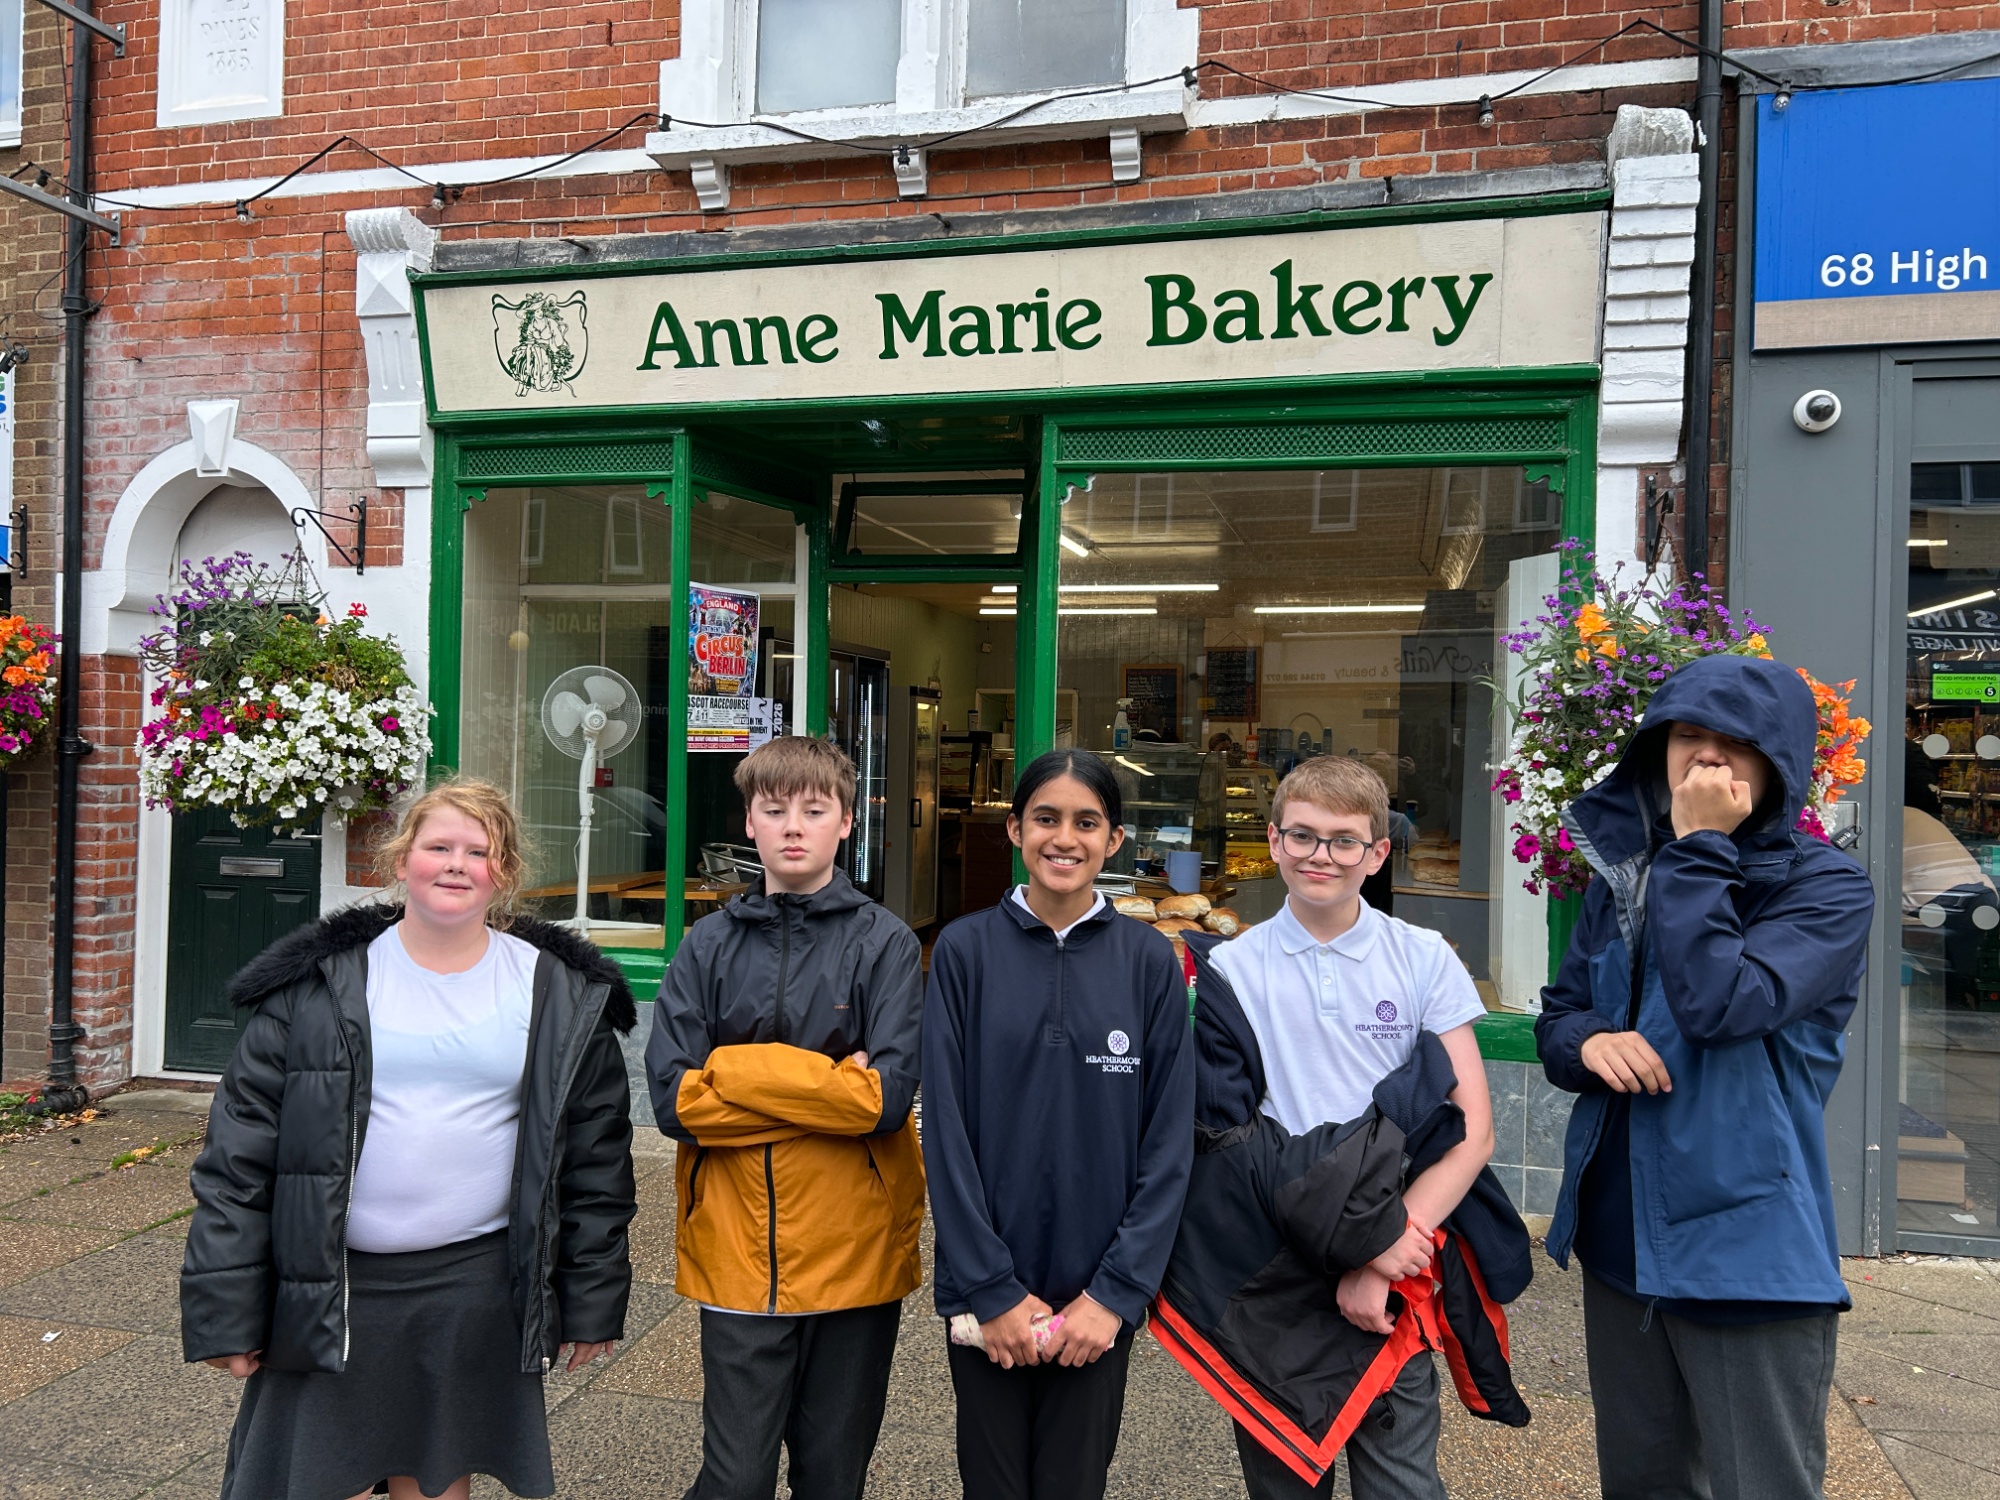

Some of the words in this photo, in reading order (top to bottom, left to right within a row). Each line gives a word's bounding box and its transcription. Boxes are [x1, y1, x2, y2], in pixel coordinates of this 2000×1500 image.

[1820, 252, 1875, 288] 68
[1891, 247, 1987, 290] High
[636, 301, 839, 371] Anne
[875, 288, 1102, 360] Marie
[1144, 258, 1494, 347] Bakery
[706, 600, 739, 611] ENGLAND
[695, 634, 744, 662] CIRCUS
[708, 655, 747, 677] BERLIN
[1986, 687, 1994, 696] 5
[687, 696, 709, 708] ASCOT
[710, 697, 749, 709] RACECOURSE
[755, 717, 763, 725] THE
[750, 726, 768, 734] MOMENT
[1102, 1064, 1134, 1073] SCHOOL
